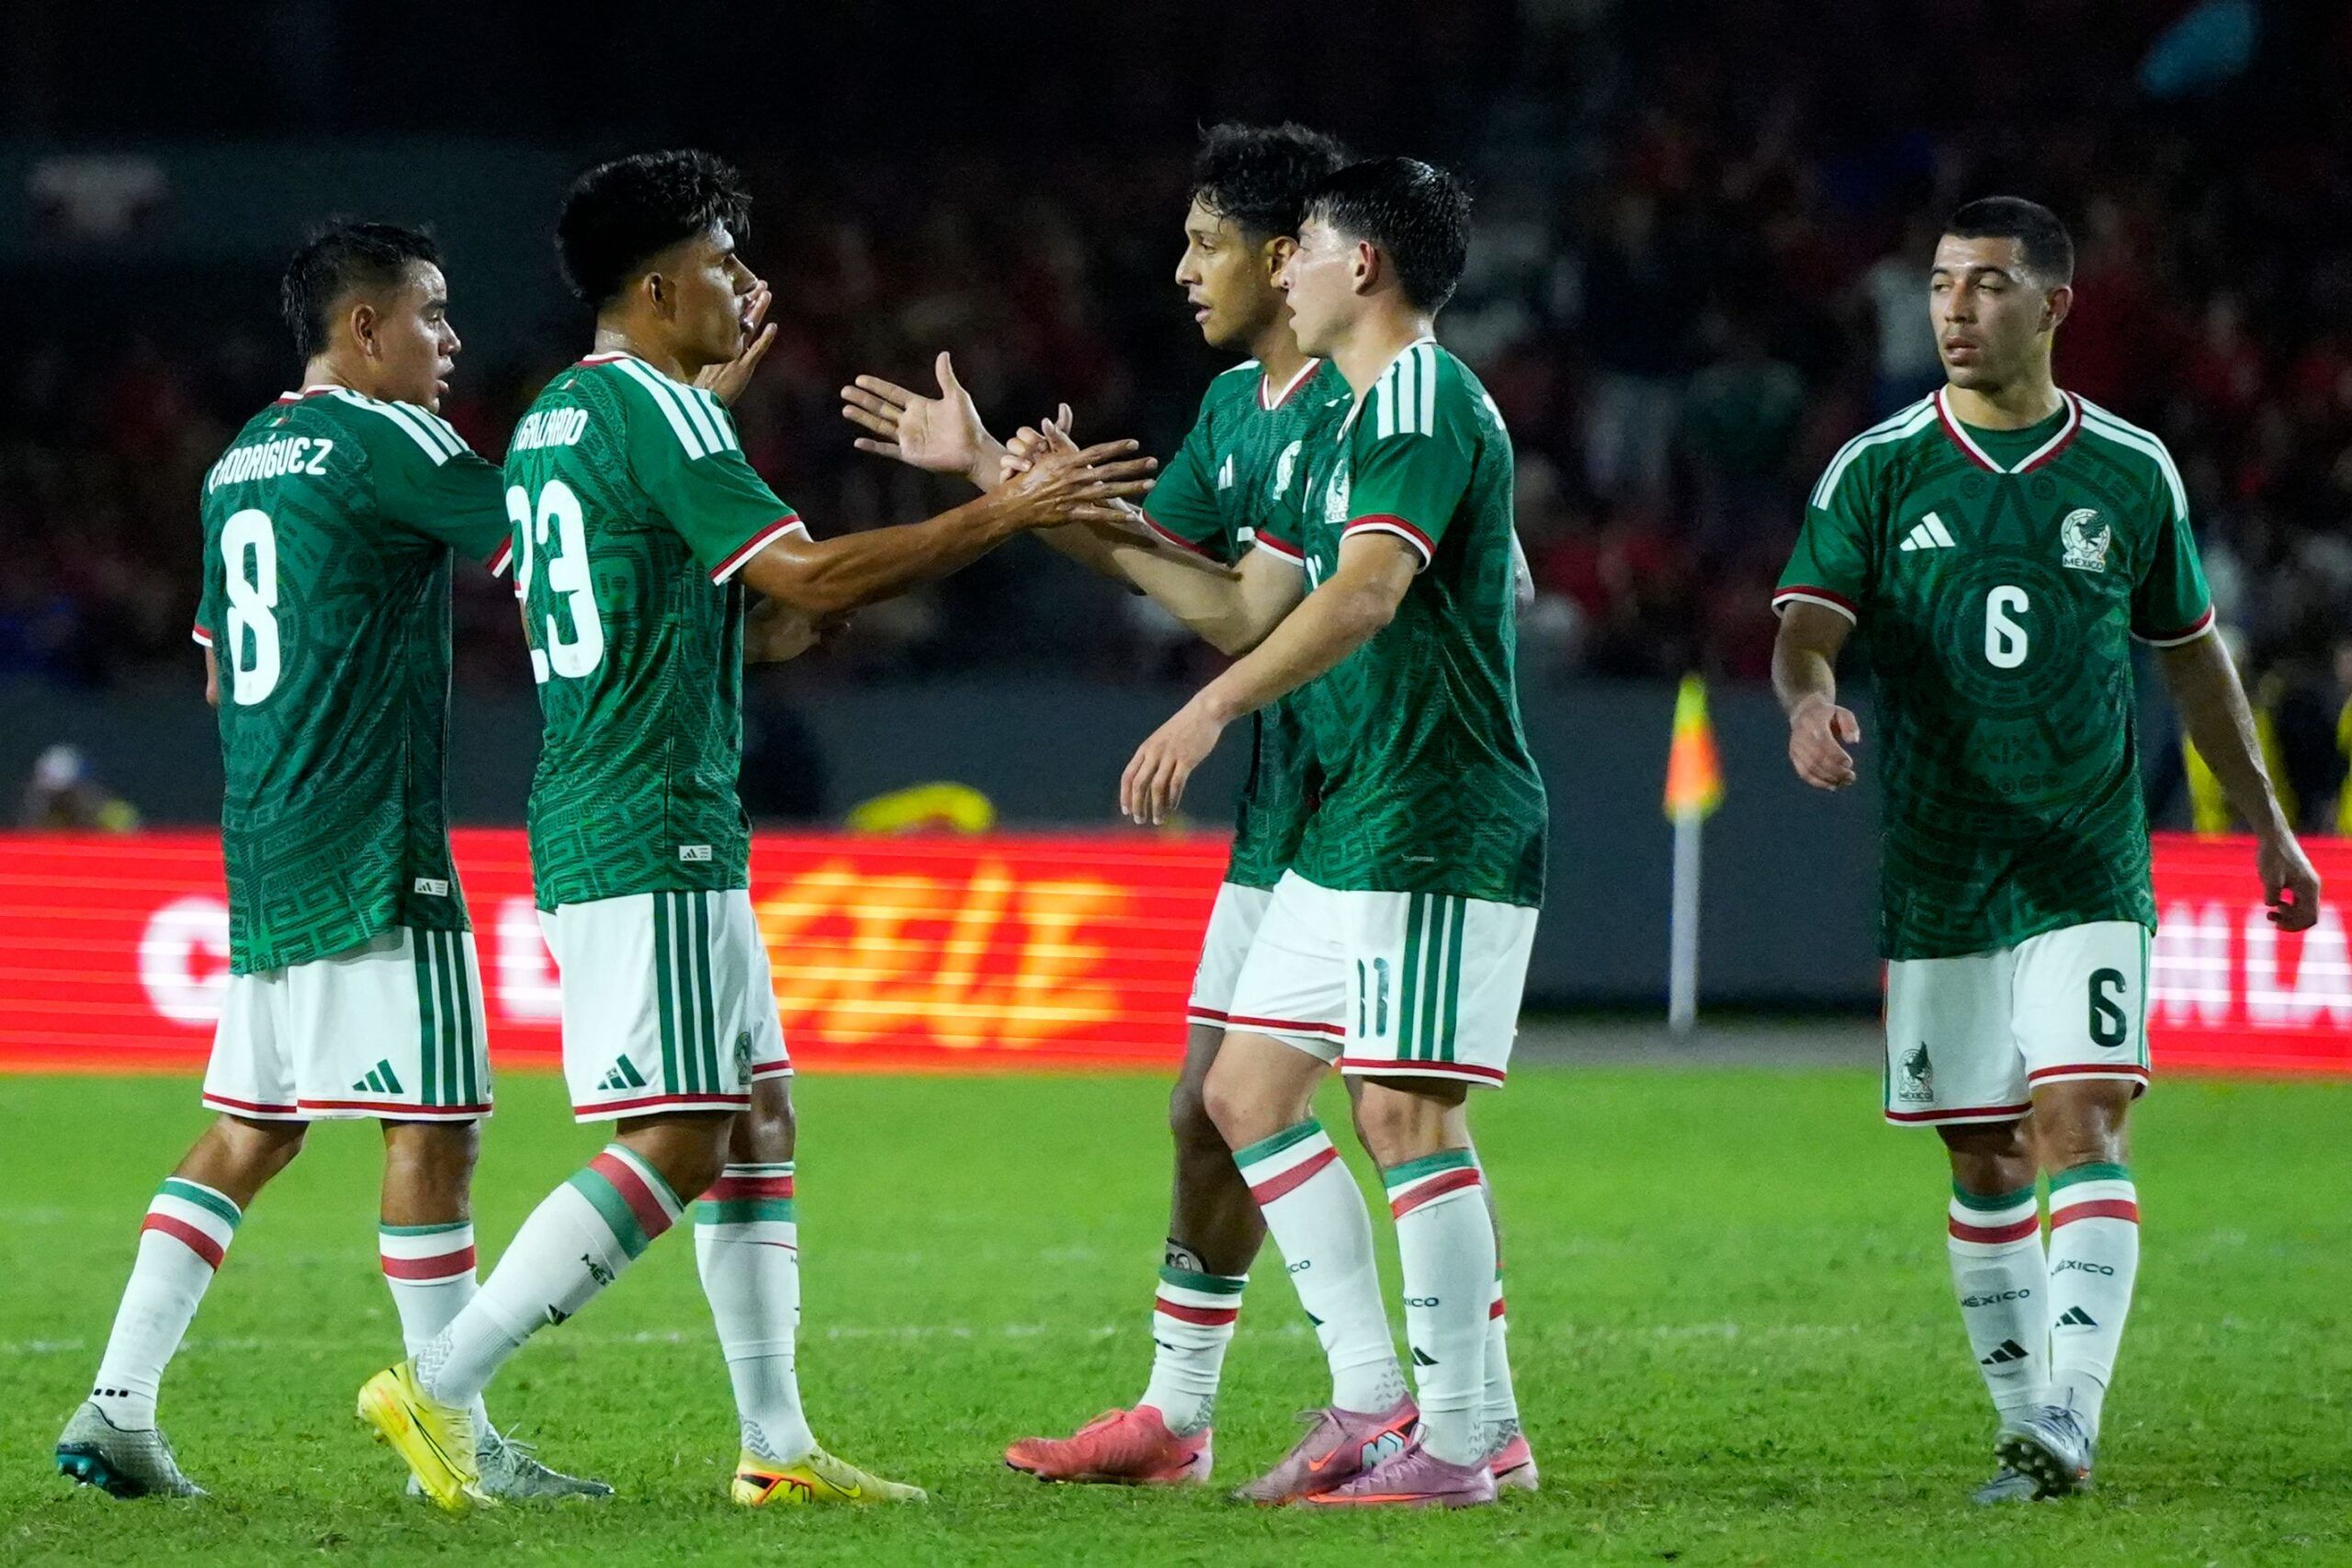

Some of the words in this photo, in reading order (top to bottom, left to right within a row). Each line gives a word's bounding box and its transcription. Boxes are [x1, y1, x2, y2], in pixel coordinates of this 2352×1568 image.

[220, 509, 280, 705] 8
[506, 479, 605, 683] 23
[1985, 585, 2030, 669] 6
[1357, 957, 1389, 1039] 11
[2088, 967, 2127, 1047] 6
